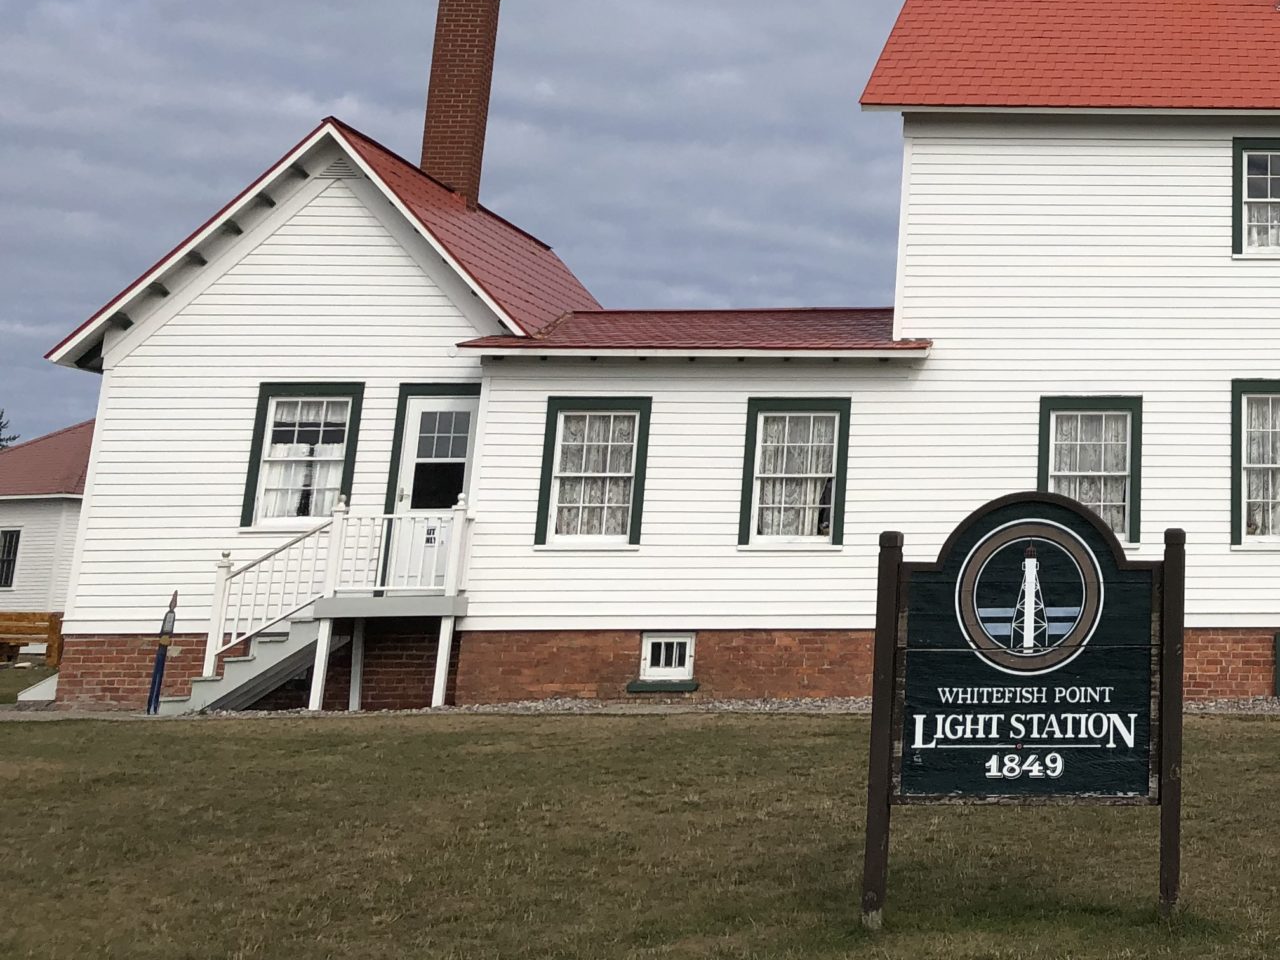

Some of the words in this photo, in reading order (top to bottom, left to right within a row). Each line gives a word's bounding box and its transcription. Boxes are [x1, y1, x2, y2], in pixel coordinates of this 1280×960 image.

[937, 686, 1048, 704] WHITEFISH
[1053, 686, 1115, 703] POINT
[911, 713, 1005, 749] LIGHT
[1009, 712, 1138, 749] STATION
[984, 752, 1065, 779] 1849
